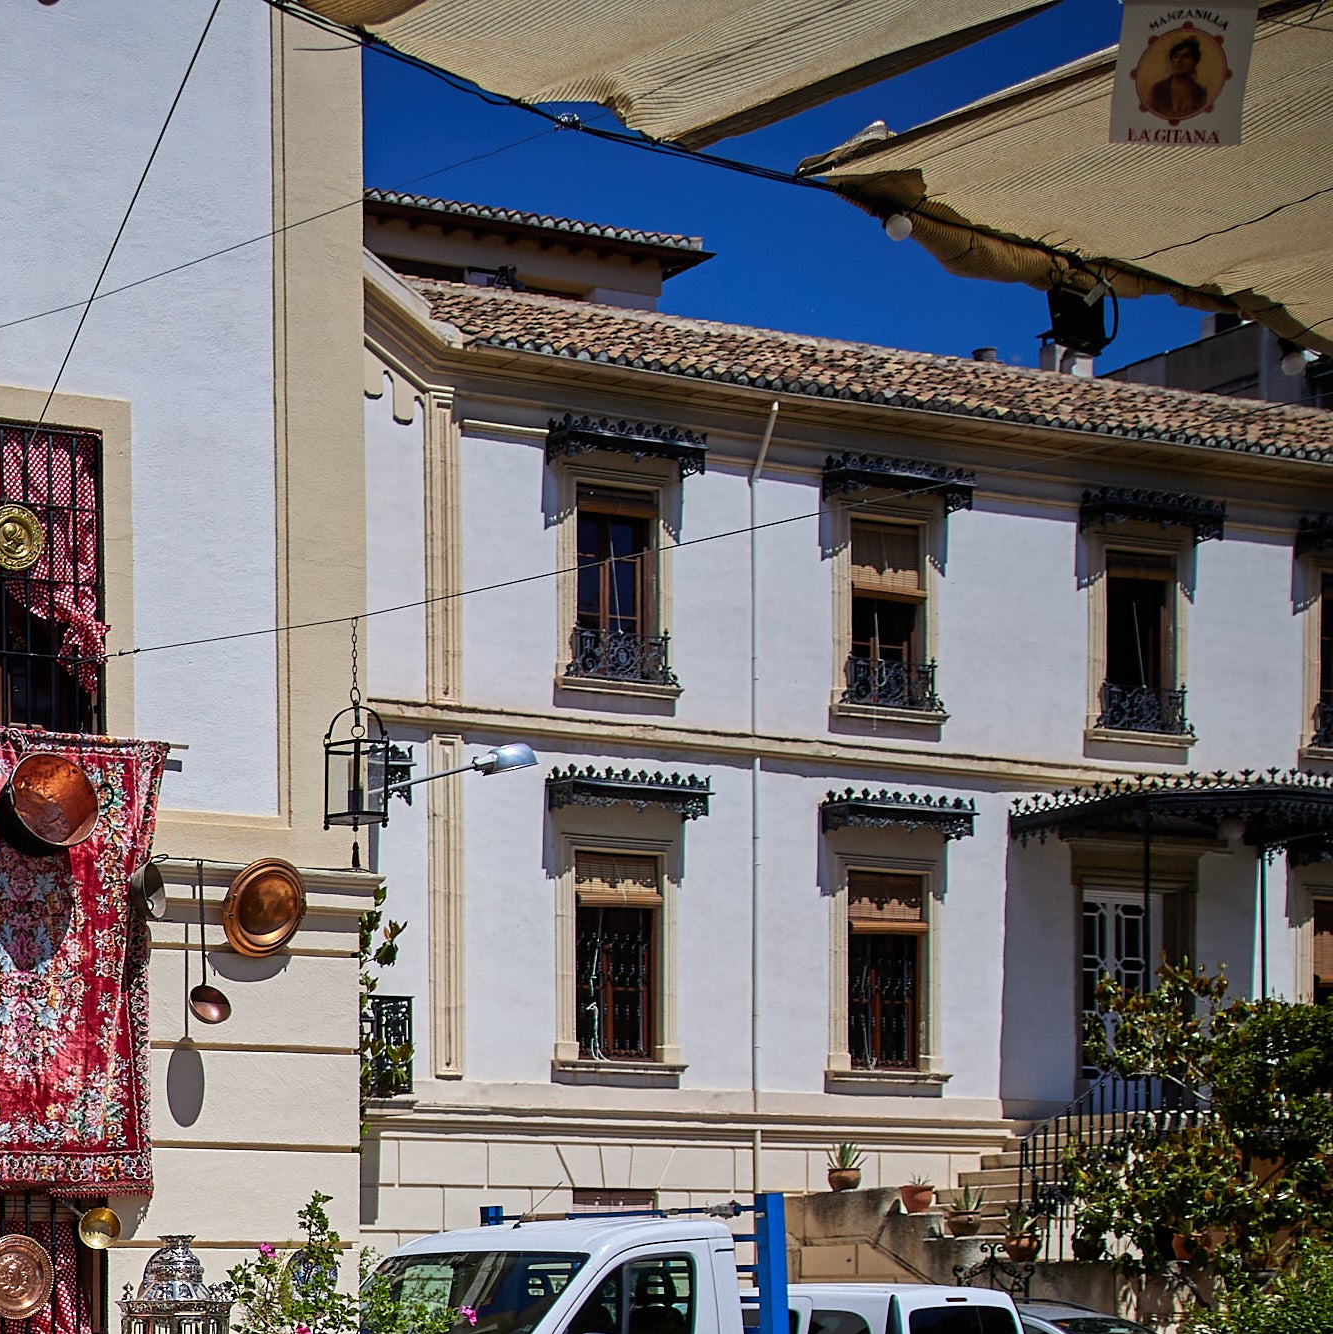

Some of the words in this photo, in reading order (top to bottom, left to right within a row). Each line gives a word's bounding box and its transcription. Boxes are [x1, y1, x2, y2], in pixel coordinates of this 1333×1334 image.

[1149, 9, 1229, 31] MANZANILLA
[1127, 128, 1151, 142] LA
[1154, 128, 1220, 144] GITANA
